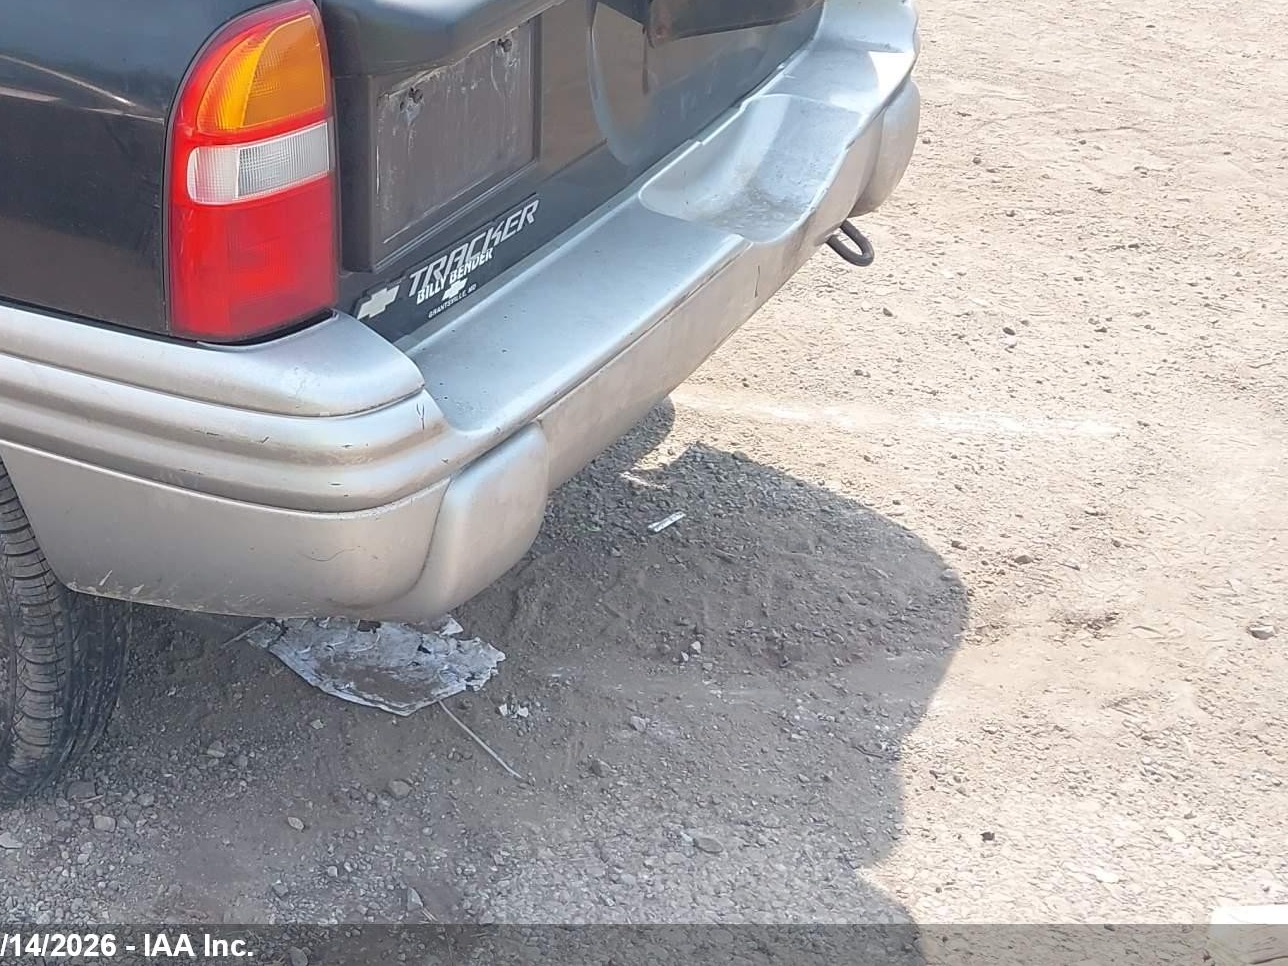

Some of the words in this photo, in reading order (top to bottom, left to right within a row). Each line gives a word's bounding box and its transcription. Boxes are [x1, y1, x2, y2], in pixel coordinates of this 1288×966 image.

[408, 199, 540, 298] TRACKER
[416, 275, 447, 305] BILLY
[449, 247, 494, 285] BENDER
